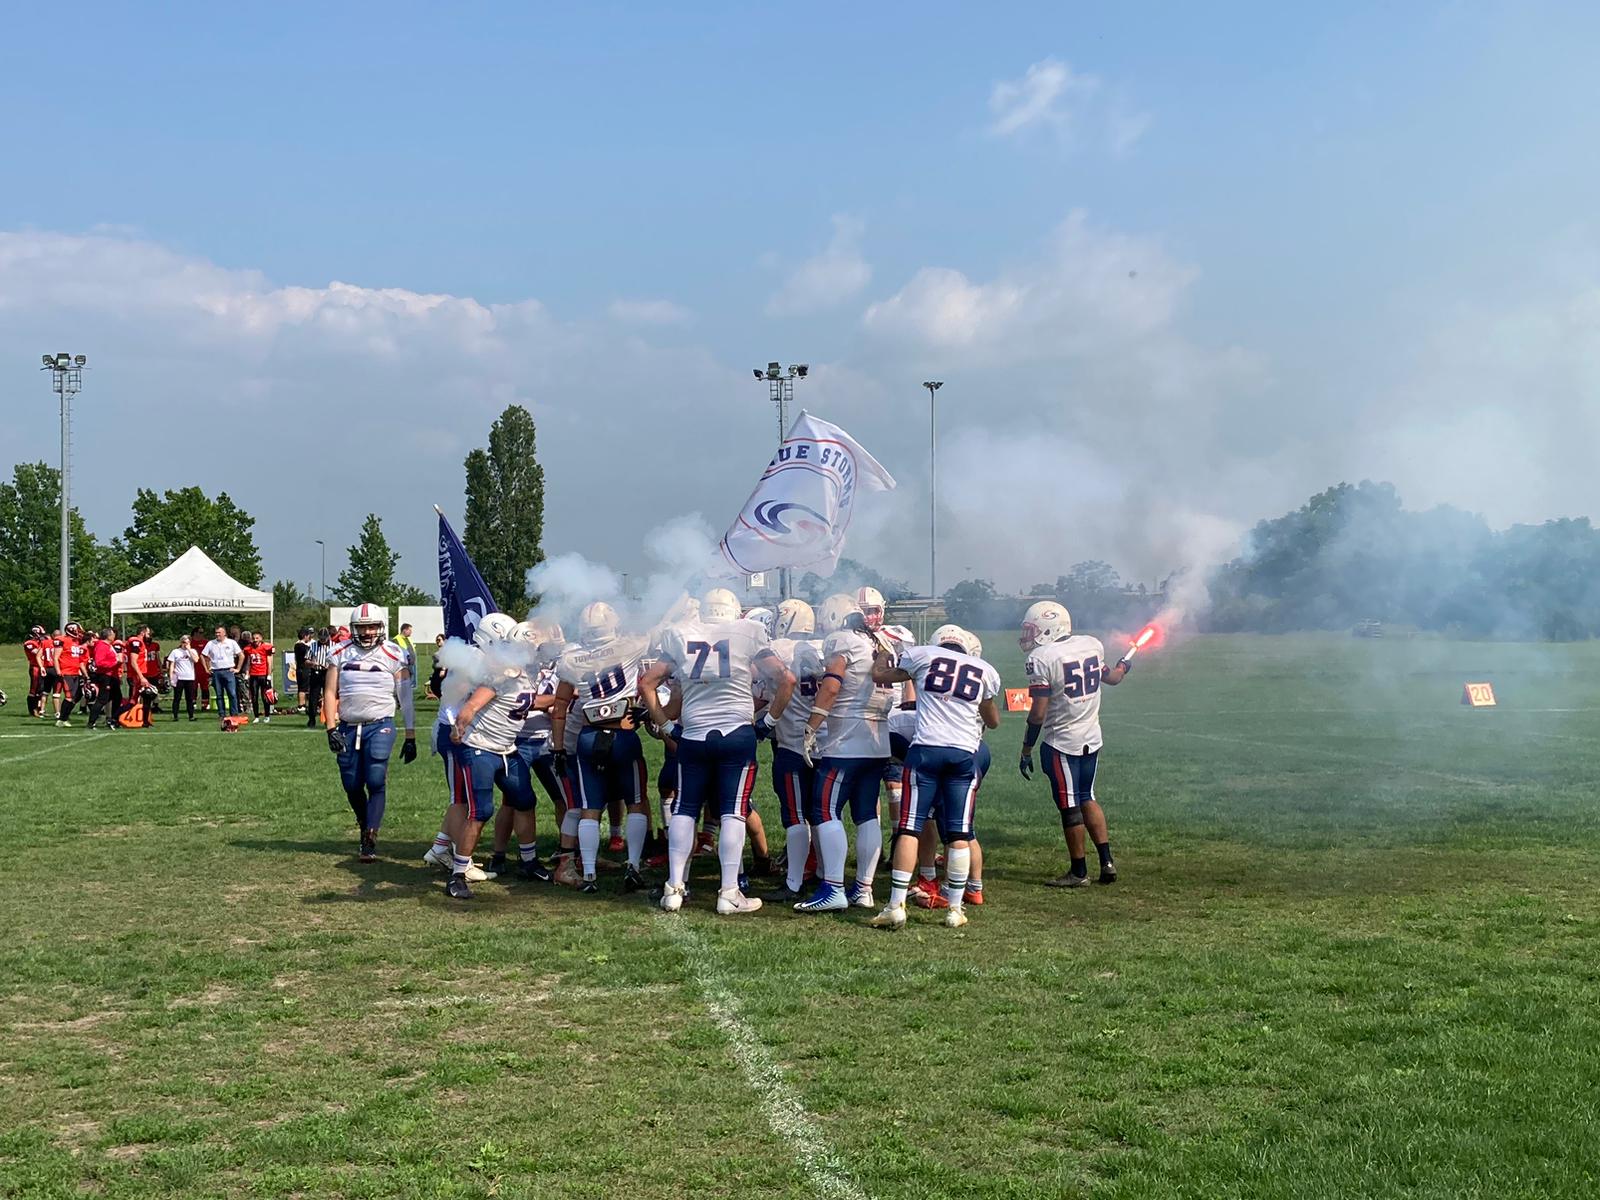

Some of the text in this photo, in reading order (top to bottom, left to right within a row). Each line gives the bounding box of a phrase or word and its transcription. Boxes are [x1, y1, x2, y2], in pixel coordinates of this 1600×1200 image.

[142, 598, 245, 609] www.evindustrial.it
[687, 639, 730, 679] 71
[1062, 655, 1100, 699] 56
[924, 657, 984, 702] 86
[1470, 686, 1491, 702] 20
